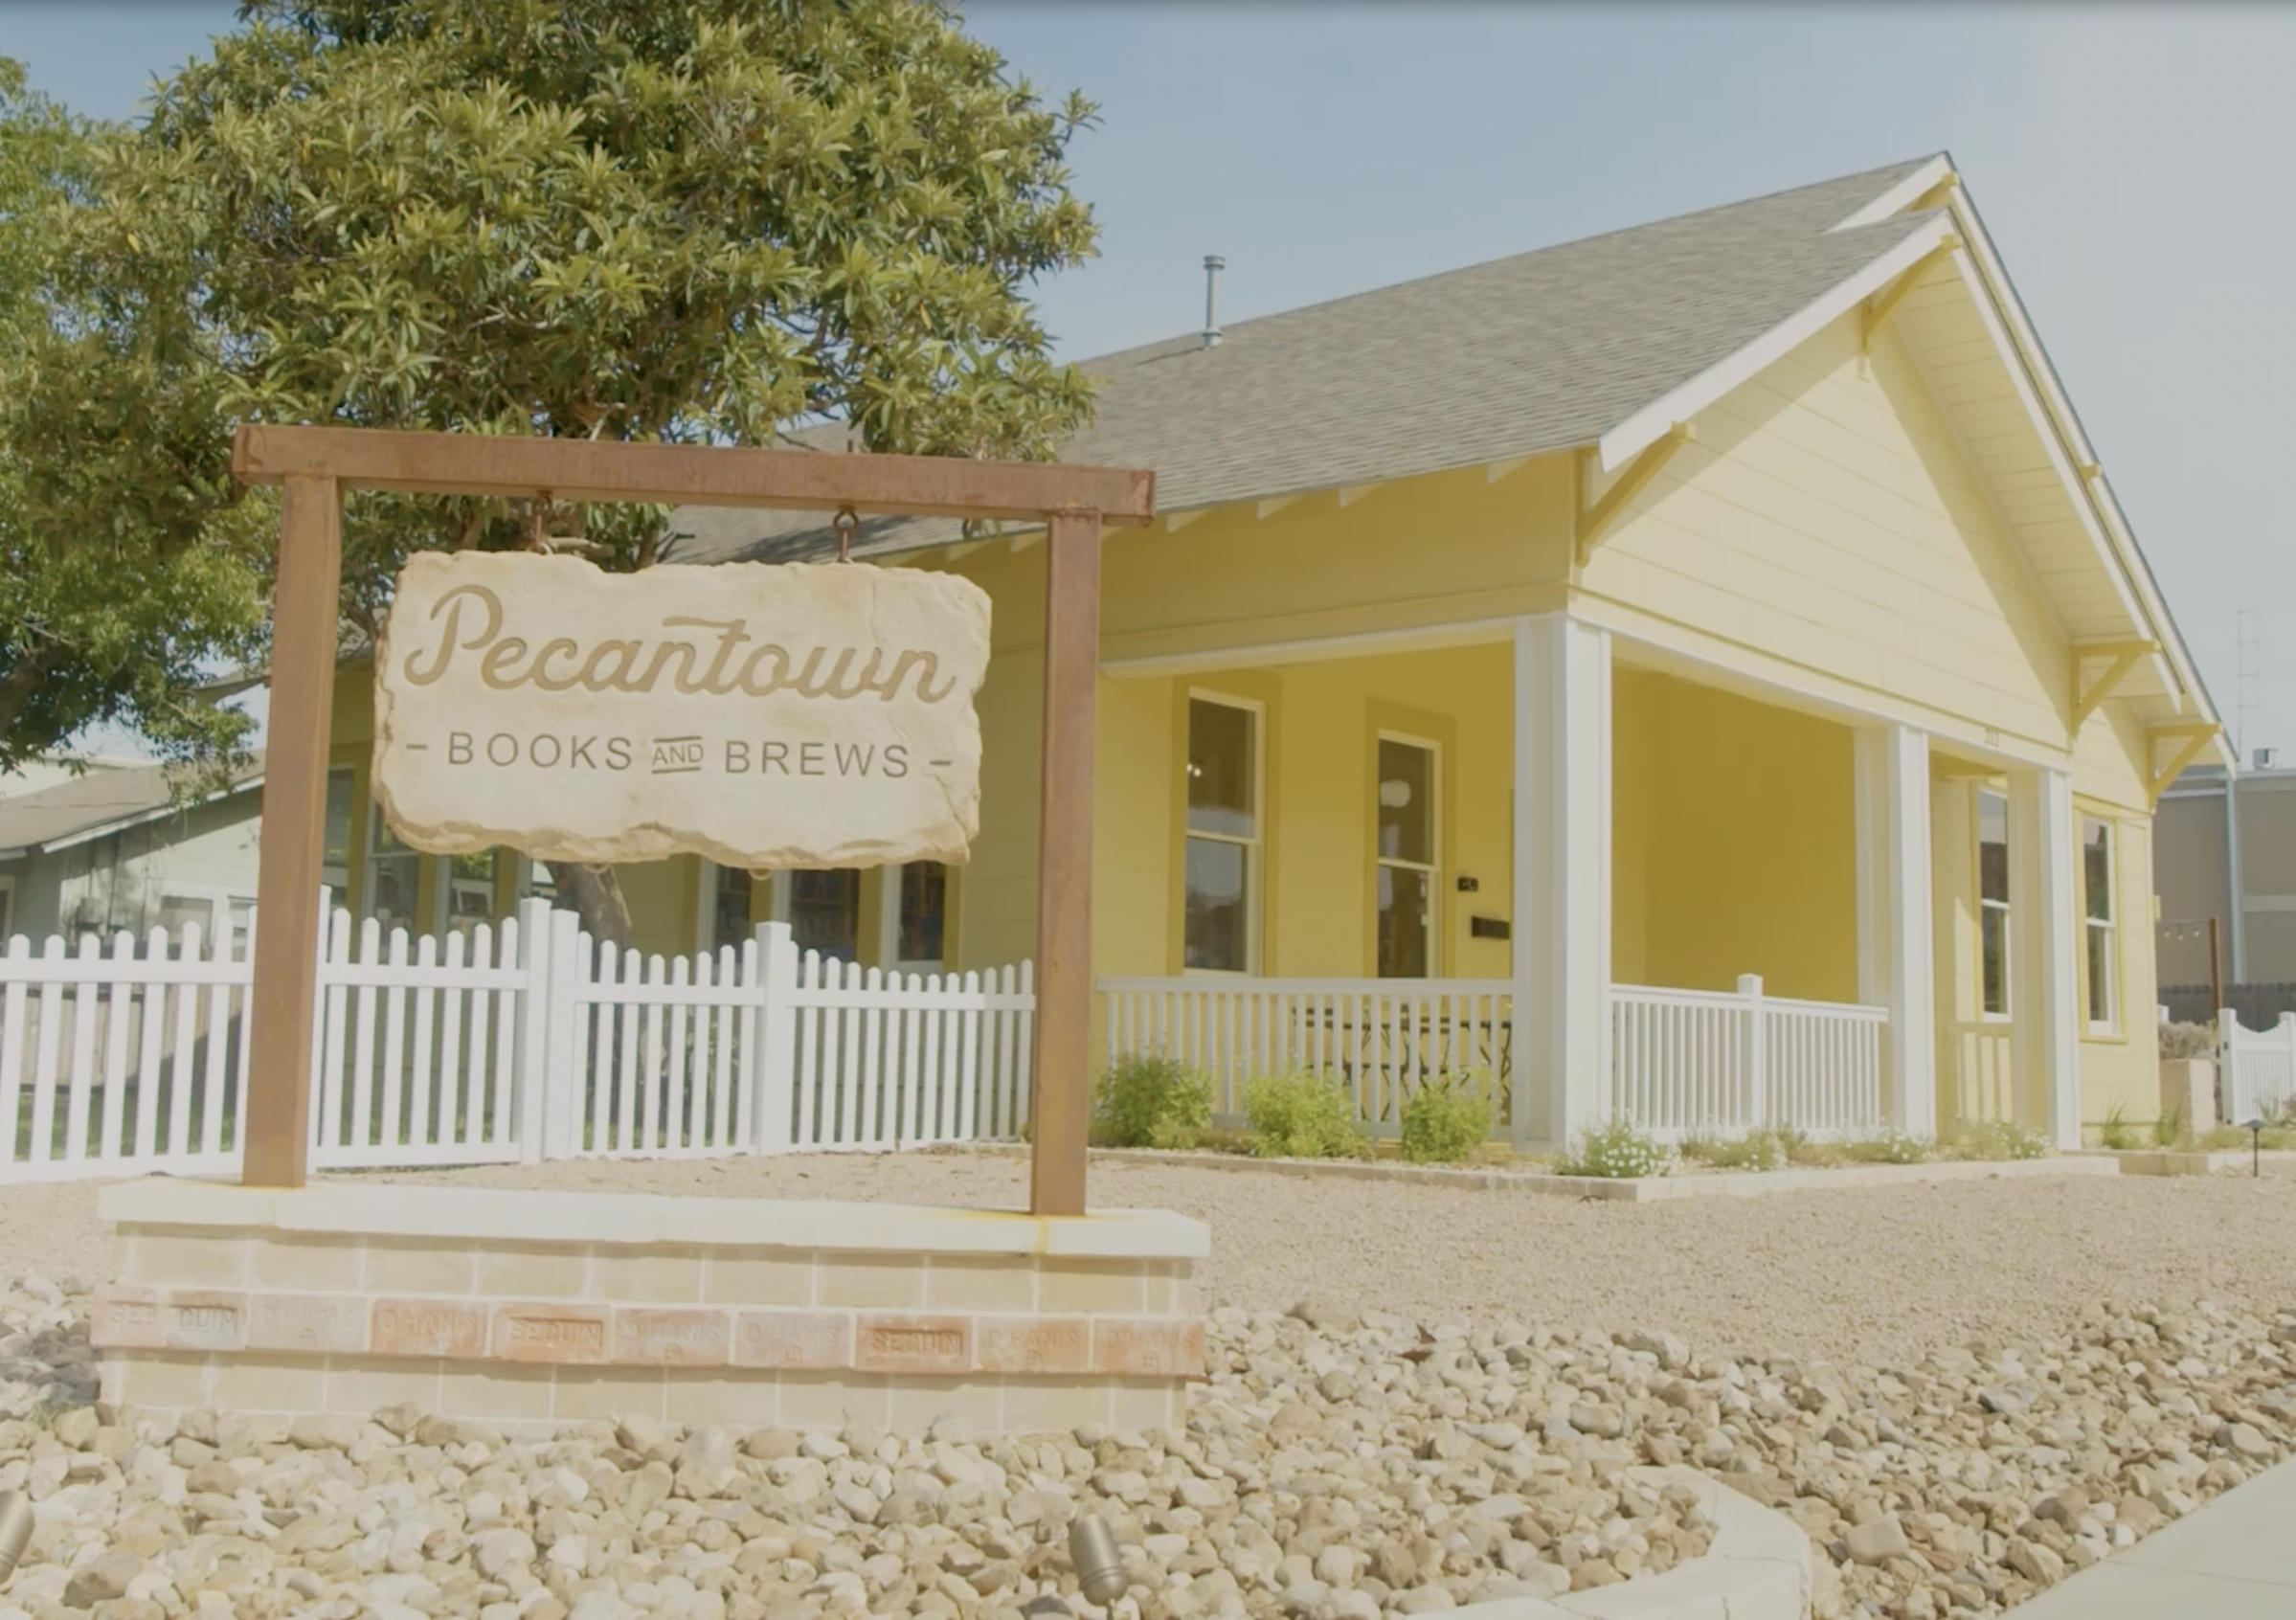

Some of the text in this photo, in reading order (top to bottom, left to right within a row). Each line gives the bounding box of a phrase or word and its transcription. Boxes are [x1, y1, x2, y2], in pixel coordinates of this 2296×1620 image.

[404, 584, 956, 703] Pecantown
[447, 731, 909, 777] BOOKS AND BREWS
